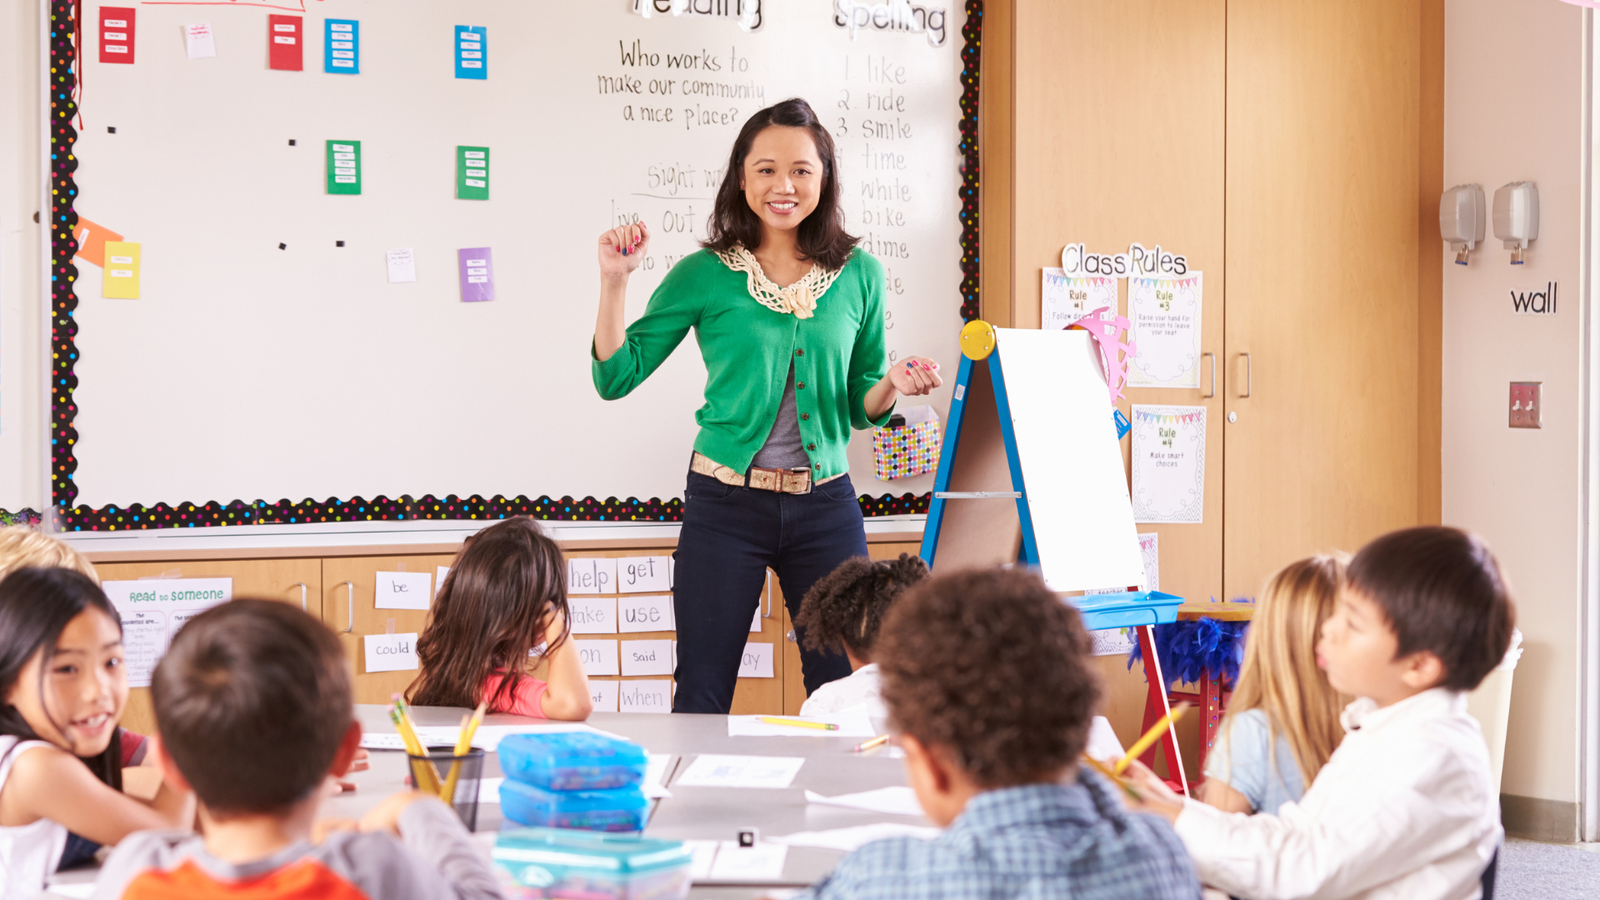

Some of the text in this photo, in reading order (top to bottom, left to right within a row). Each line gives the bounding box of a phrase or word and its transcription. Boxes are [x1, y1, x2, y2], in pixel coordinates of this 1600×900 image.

[634, 0, 762, 29] eaing
[835, 0, 946, 44] Spelling
[620, 38, 749, 73] Who works to
[867, 54, 907, 85] like
[598, 74, 765, 108] make our community
[867, 87, 905, 113] ride
[623, 103, 739, 130] a nice place?
[862, 117, 913, 141] smile
[862, 143, 907, 171] time
[861, 177, 912, 203] white
[662, 205, 696, 233] out
[862, 199, 906, 227] bike
[862, 231, 910, 259] dime
[1065, 245, 1187, 275] Class Rules
[1069, 289, 1087, 301] Rule
[1156, 289, 1174, 301] Rule
[1510, 281, 1557, 314] wall
[1158, 427, 1177, 438] Rule
[392, 580, 409, 593] be
[571, 558, 656, 593] help get
[130, 590, 156, 602] Read
[171, 590, 224, 602] someone
[570, 605, 661, 624] take use
[376, 641, 410, 655] could
[742, 652, 761, 671] ay
[622, 687, 663, 706] when
